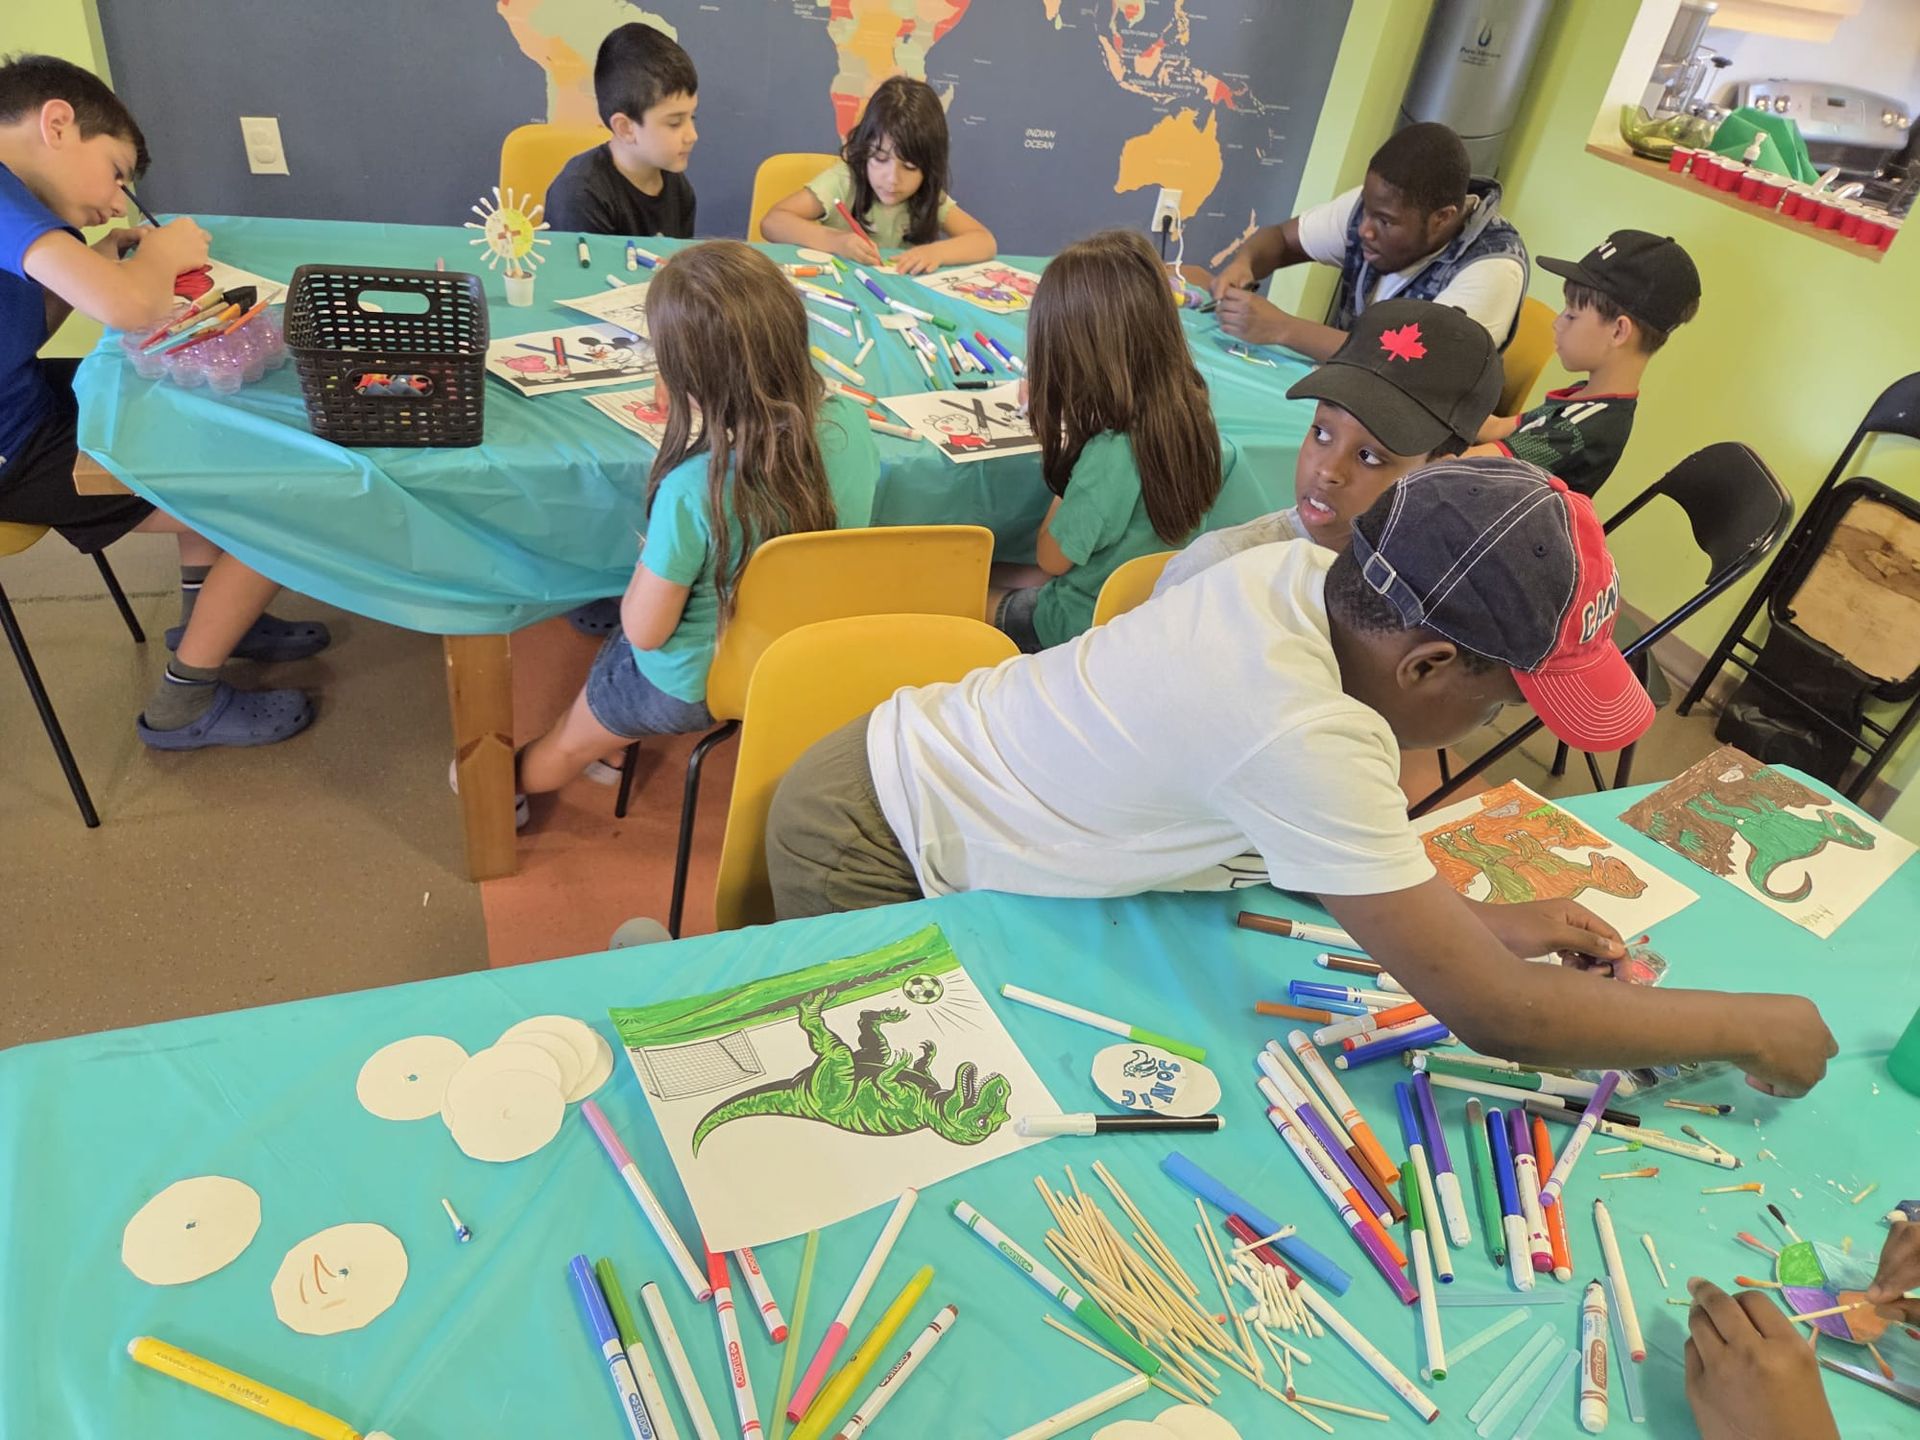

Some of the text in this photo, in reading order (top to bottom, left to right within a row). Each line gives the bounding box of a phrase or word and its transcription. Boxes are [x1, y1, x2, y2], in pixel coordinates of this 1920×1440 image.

[1024, 139, 1055, 150] OCEAN
[1025, 128, 1056, 138] INDIAN
[1579, 572, 1620, 644] CAN
[731, 1353, 745, 1383] STUDIO
[1592, 1343, 1605, 1382] Crayola
[633, 1404, 651, 1436] STUDIO
